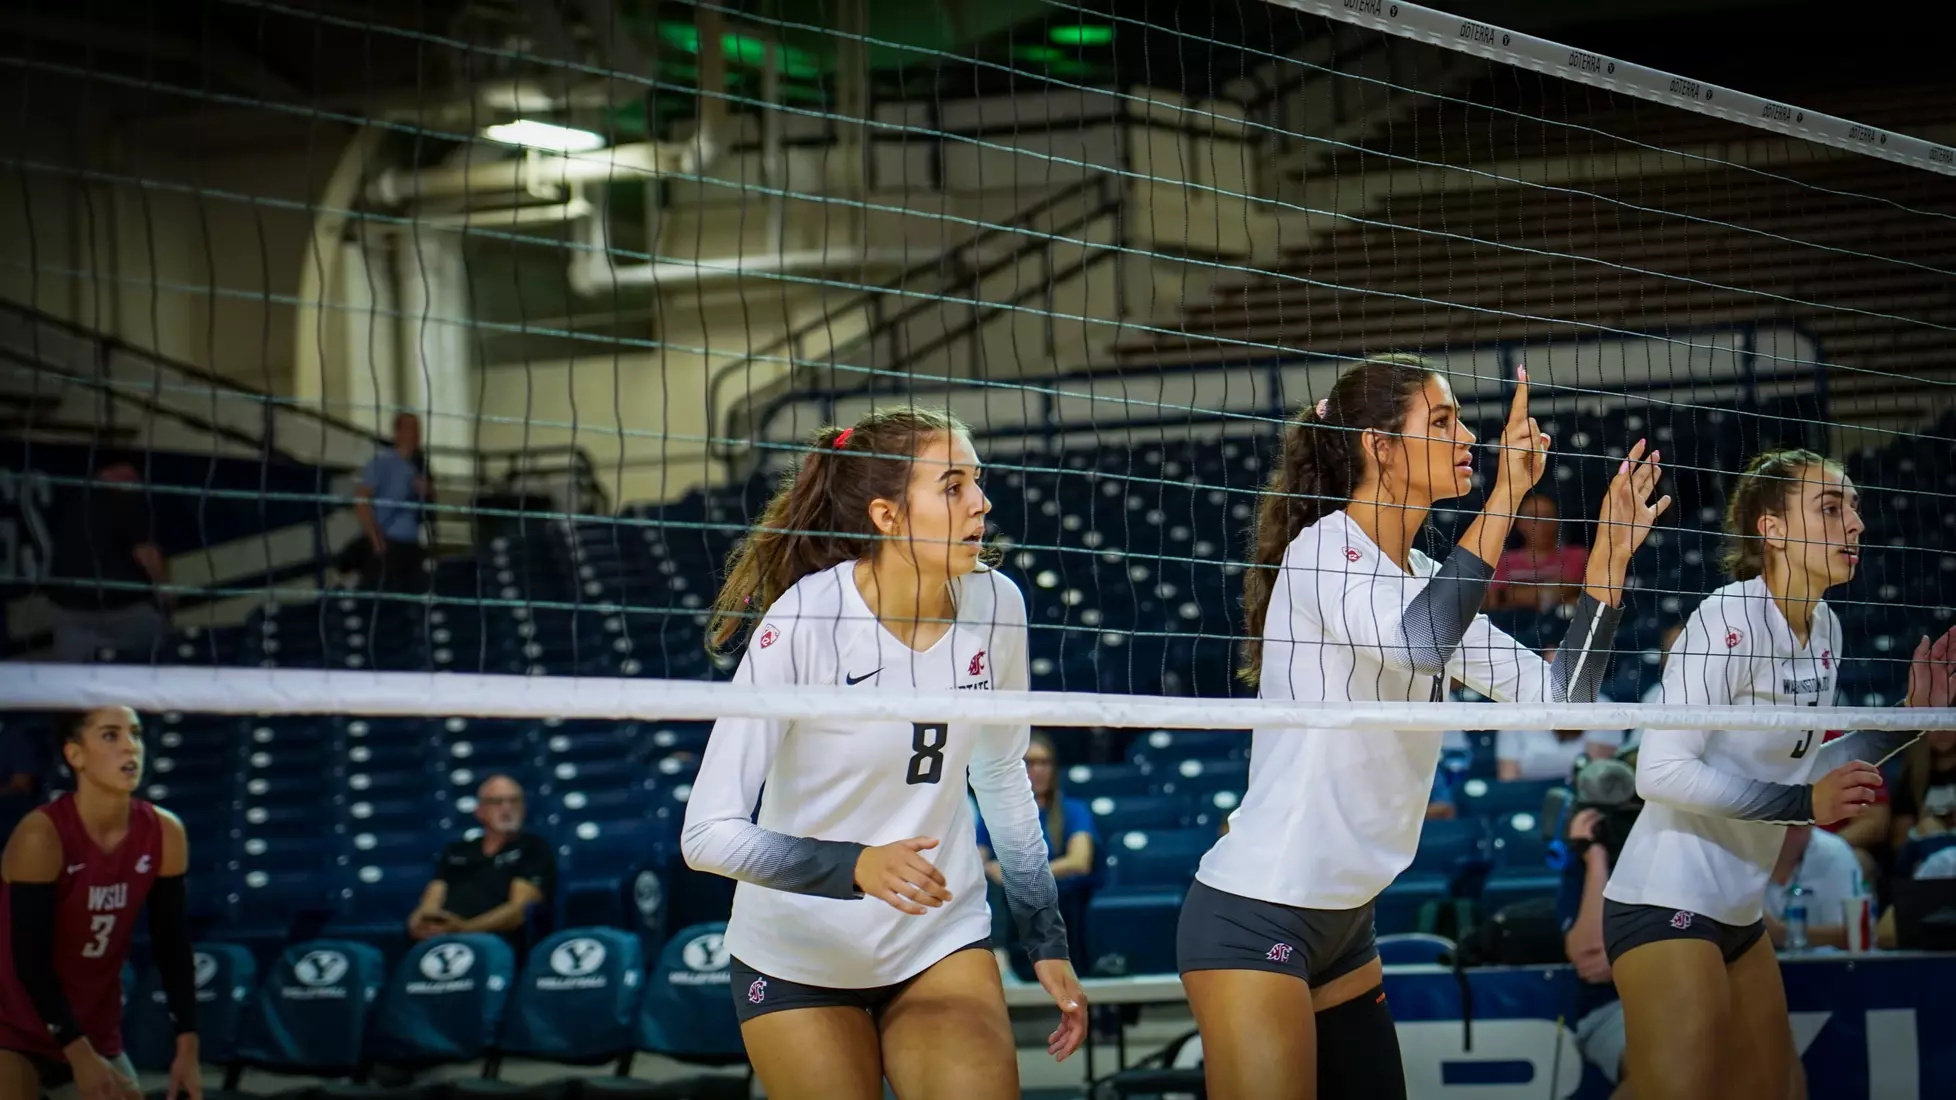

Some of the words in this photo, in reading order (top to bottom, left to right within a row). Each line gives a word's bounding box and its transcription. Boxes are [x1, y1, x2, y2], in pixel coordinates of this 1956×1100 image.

[906, 722, 948, 785] 8
[88, 882, 128, 911] WSU
[82, 914, 116, 958] 3
